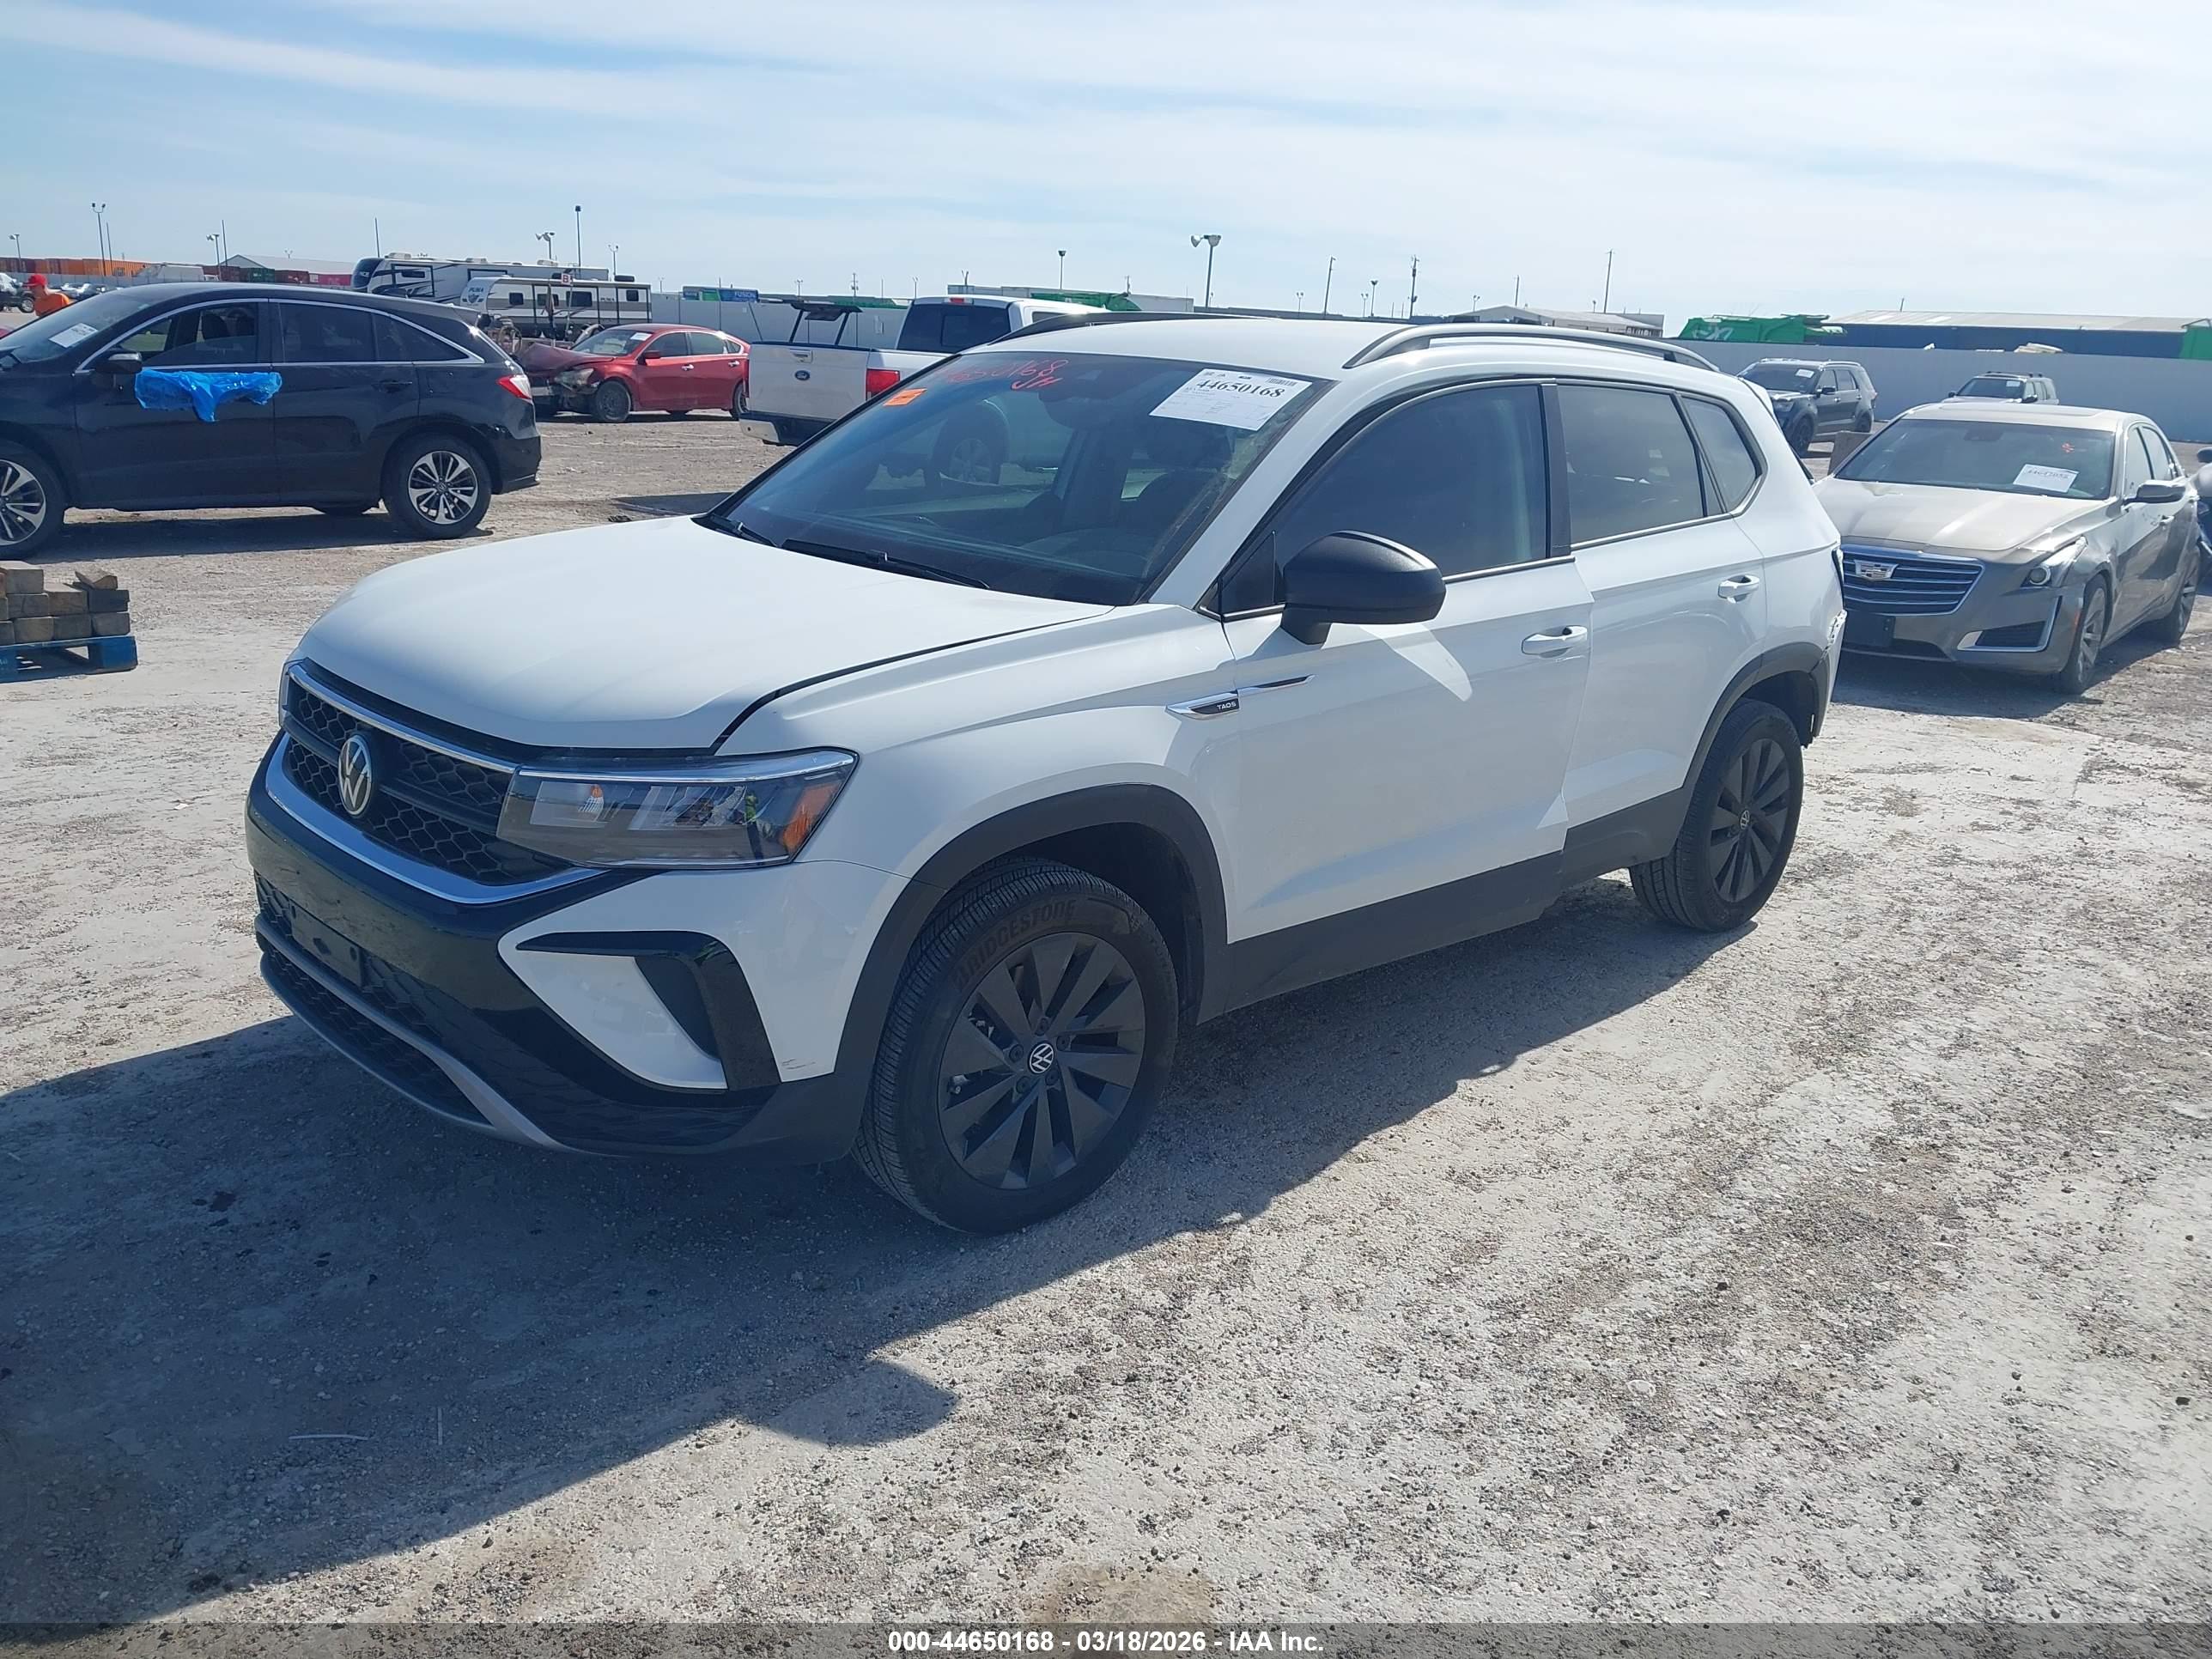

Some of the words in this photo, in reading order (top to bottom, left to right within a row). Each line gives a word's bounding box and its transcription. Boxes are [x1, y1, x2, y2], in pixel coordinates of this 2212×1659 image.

[1196, 380, 1285, 398] 44650168
[1217, 701, 1237, 710] TAOS
[952, 898, 1077, 988] BRIDGESTONE
